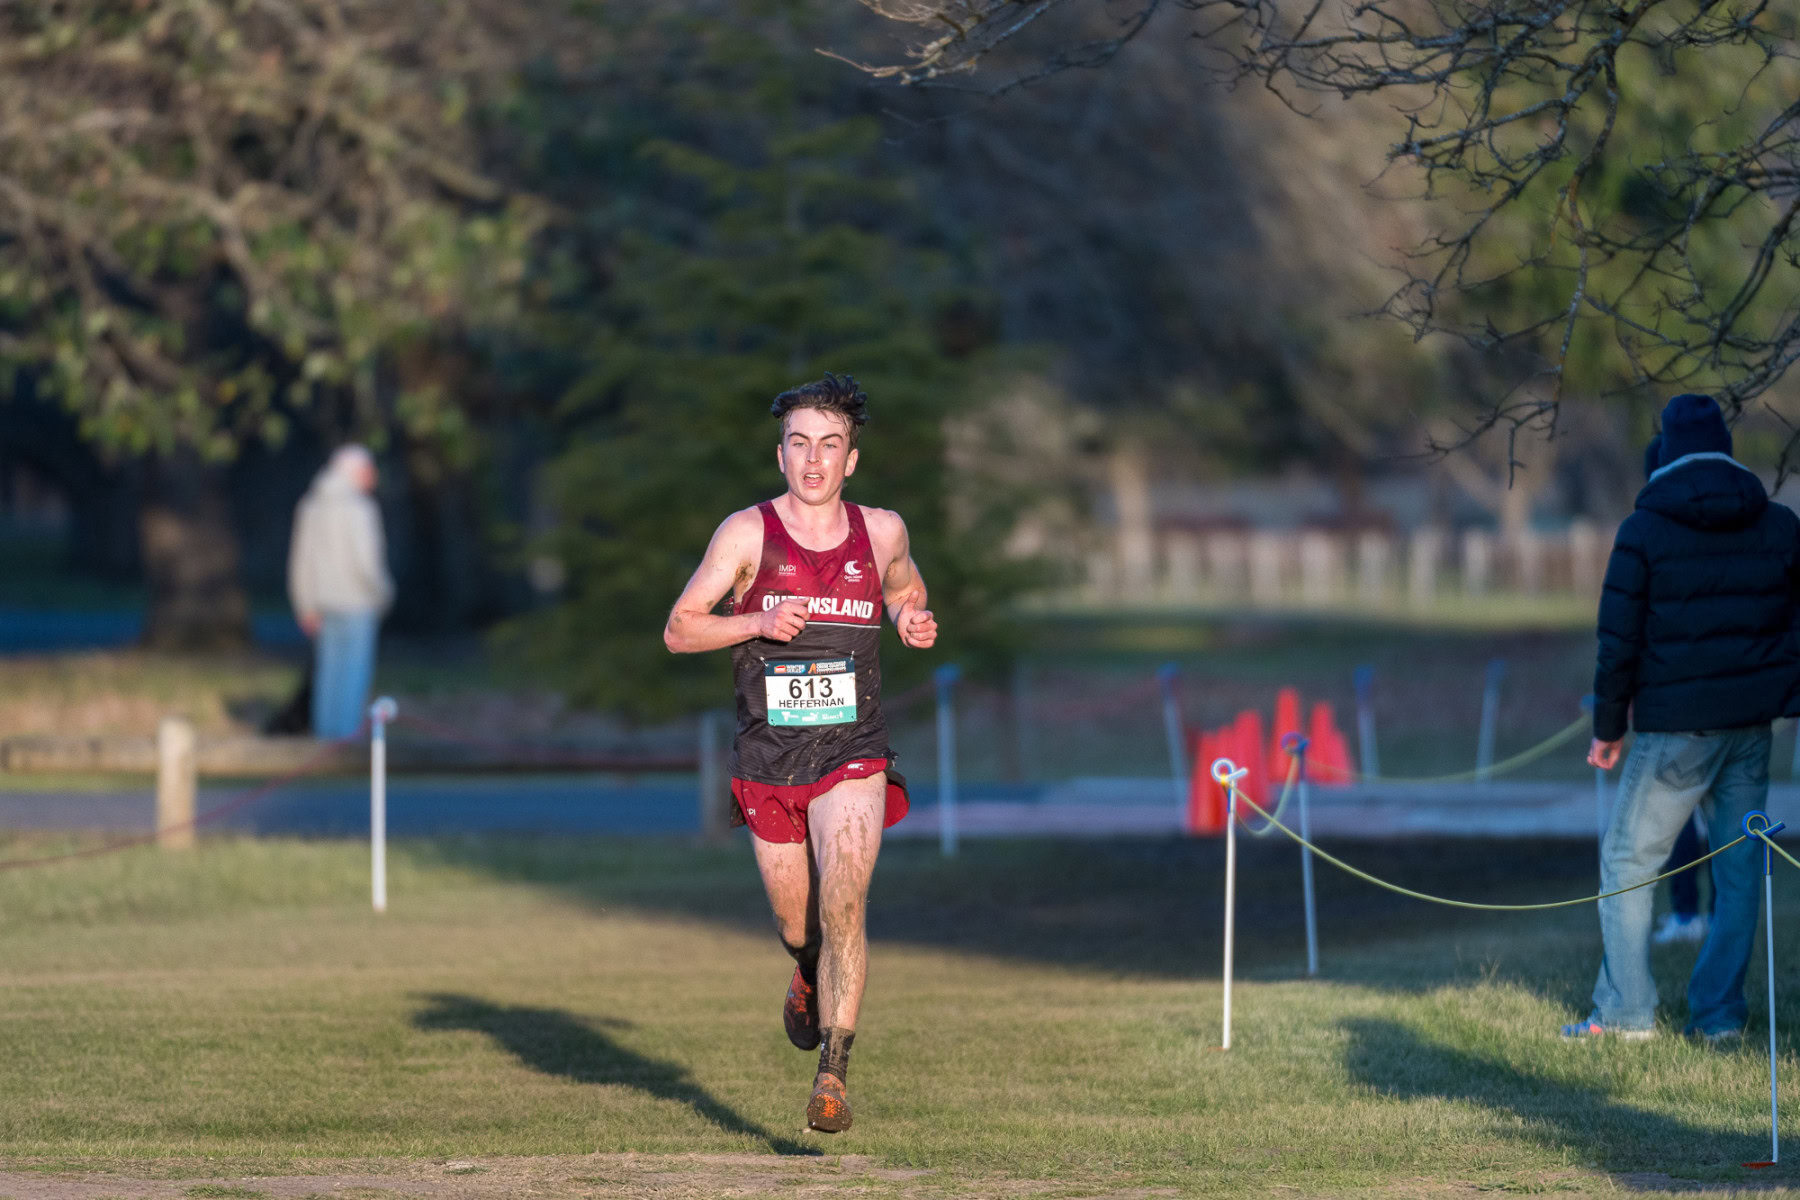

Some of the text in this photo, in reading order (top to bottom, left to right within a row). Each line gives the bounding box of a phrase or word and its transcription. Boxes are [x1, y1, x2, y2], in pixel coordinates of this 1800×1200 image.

[779, 564, 796, 572] IMPI
[762, 595, 874, 619] QUNSLAND
[789, 677, 833, 699] 613
[778, 698, 844, 708] HEFFERNAN
